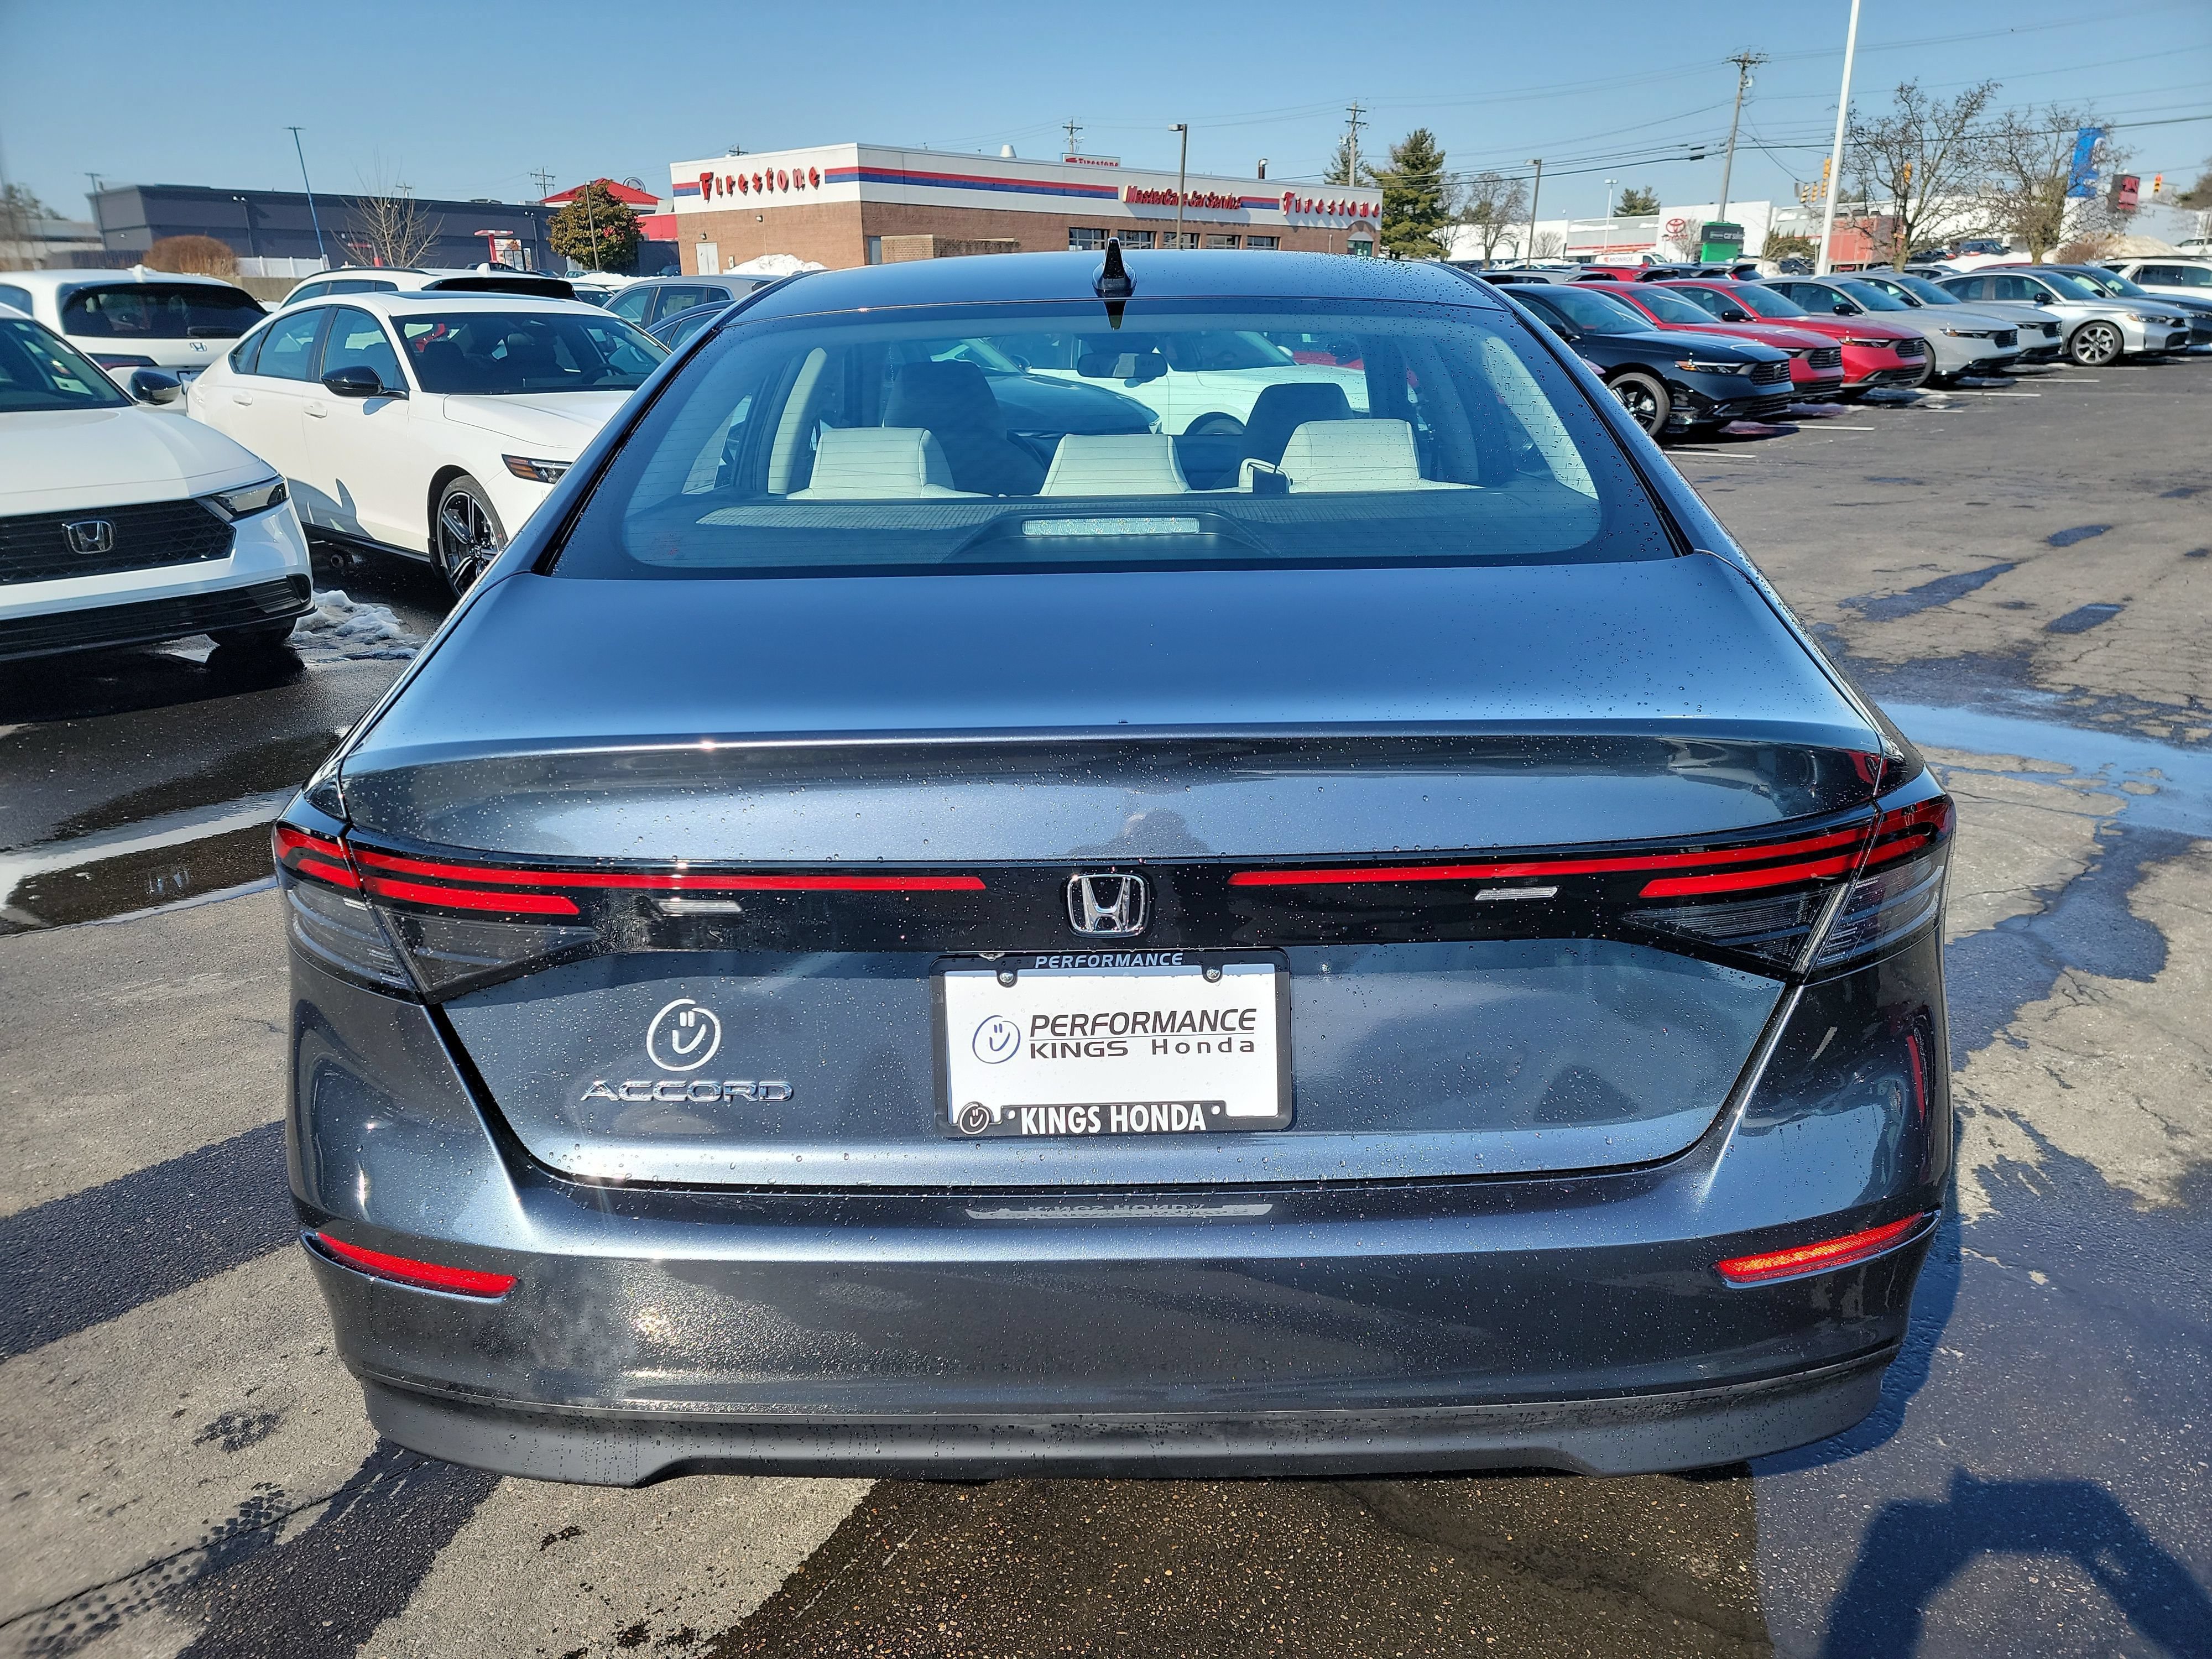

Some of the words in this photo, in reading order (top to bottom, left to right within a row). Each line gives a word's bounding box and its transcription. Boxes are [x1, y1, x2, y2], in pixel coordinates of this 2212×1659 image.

[700, 166, 820, 204] Firestone
[1123, 185, 1188, 206] MasterCae
[1188, 190, 1207, 207] Car
[1206, 191, 1241, 209] Service
[1282, 191, 1380, 217] Firestone
[1035, 952, 1183, 968] PERFORMANCE
[1030, 1008, 1256, 1037] PERFORMANCE
[1030, 1040, 1129, 1059] KINGS
[1152, 1037, 1255, 1055] Honda
[580, 1080, 793, 1102] ACCORD
[1021, 1105, 1102, 1135] KINGS
[1110, 1104, 1207, 1133] HONDA
